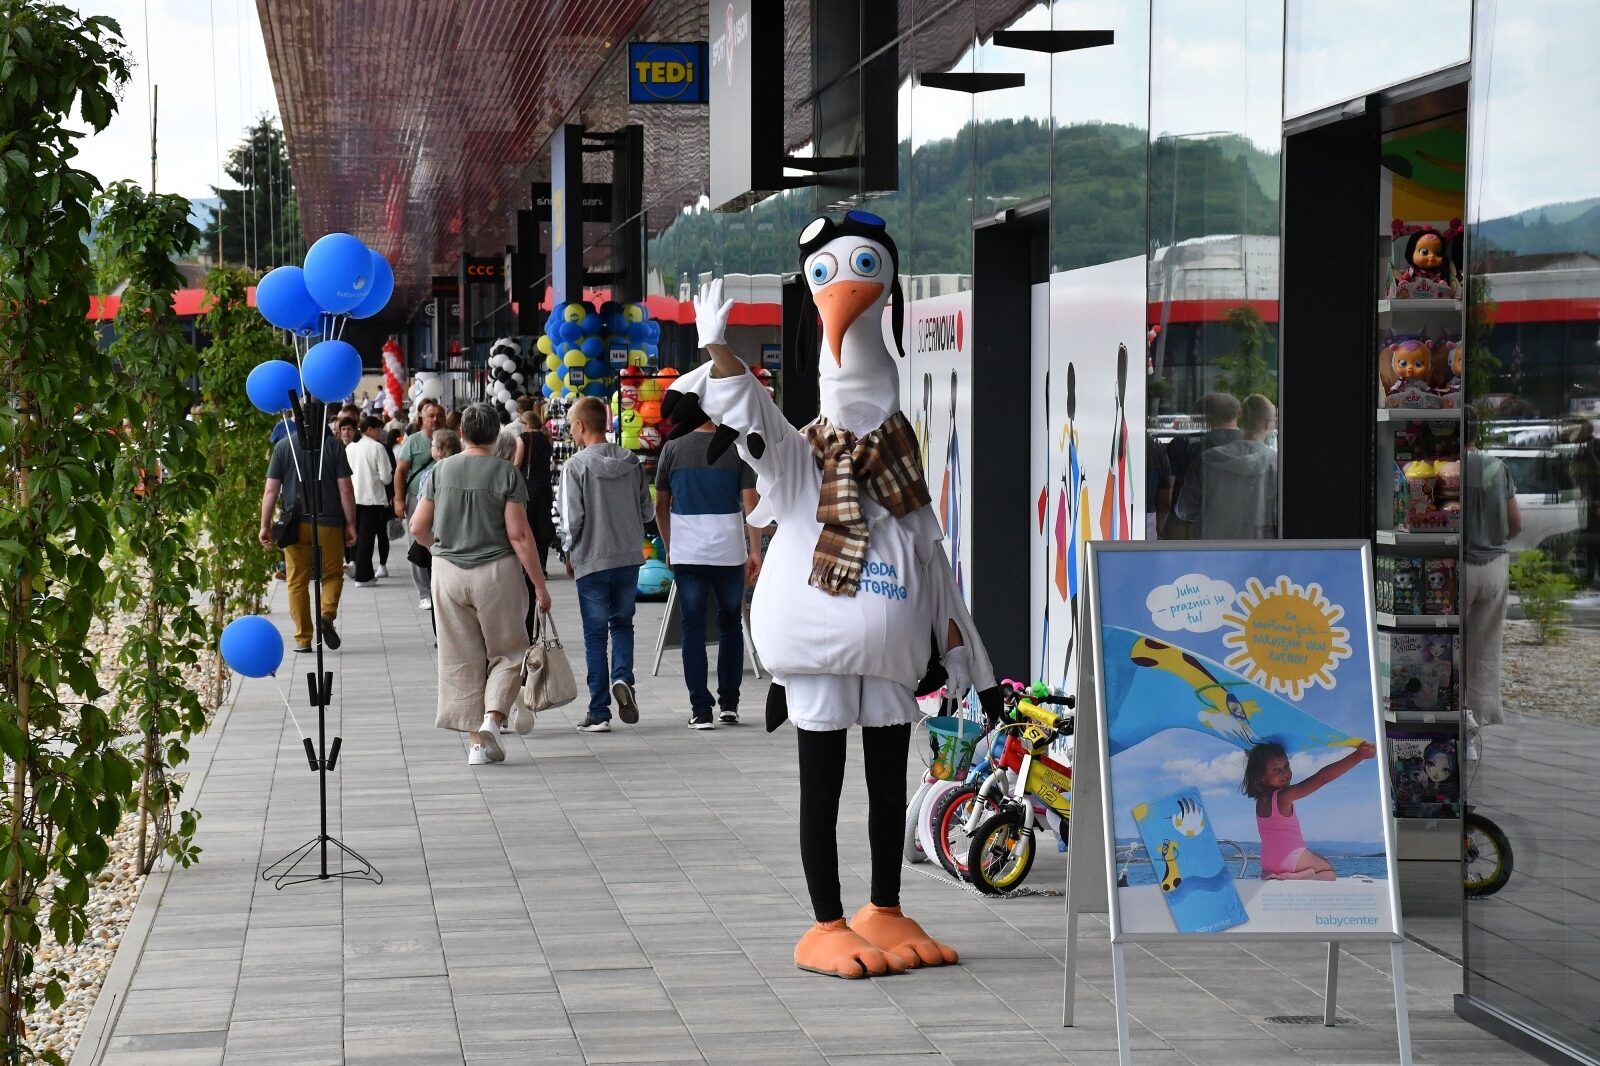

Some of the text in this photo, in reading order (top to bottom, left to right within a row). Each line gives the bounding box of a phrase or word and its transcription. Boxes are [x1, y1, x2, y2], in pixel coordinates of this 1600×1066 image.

[635, 62, 694, 83] TEDi
[467, 265, 494, 276] CCC
[918, 315, 956, 353] SUPERNOVA
[861, 560, 897, 579] RODA
[1176, 584, 1200, 599] Juhu
[1170, 595, 1211, 618] praznici
[1214, 595, 1225, 606] su
[1038, 785, 1057, 806] 12
[1315, 914, 1379, 927] babycenter
